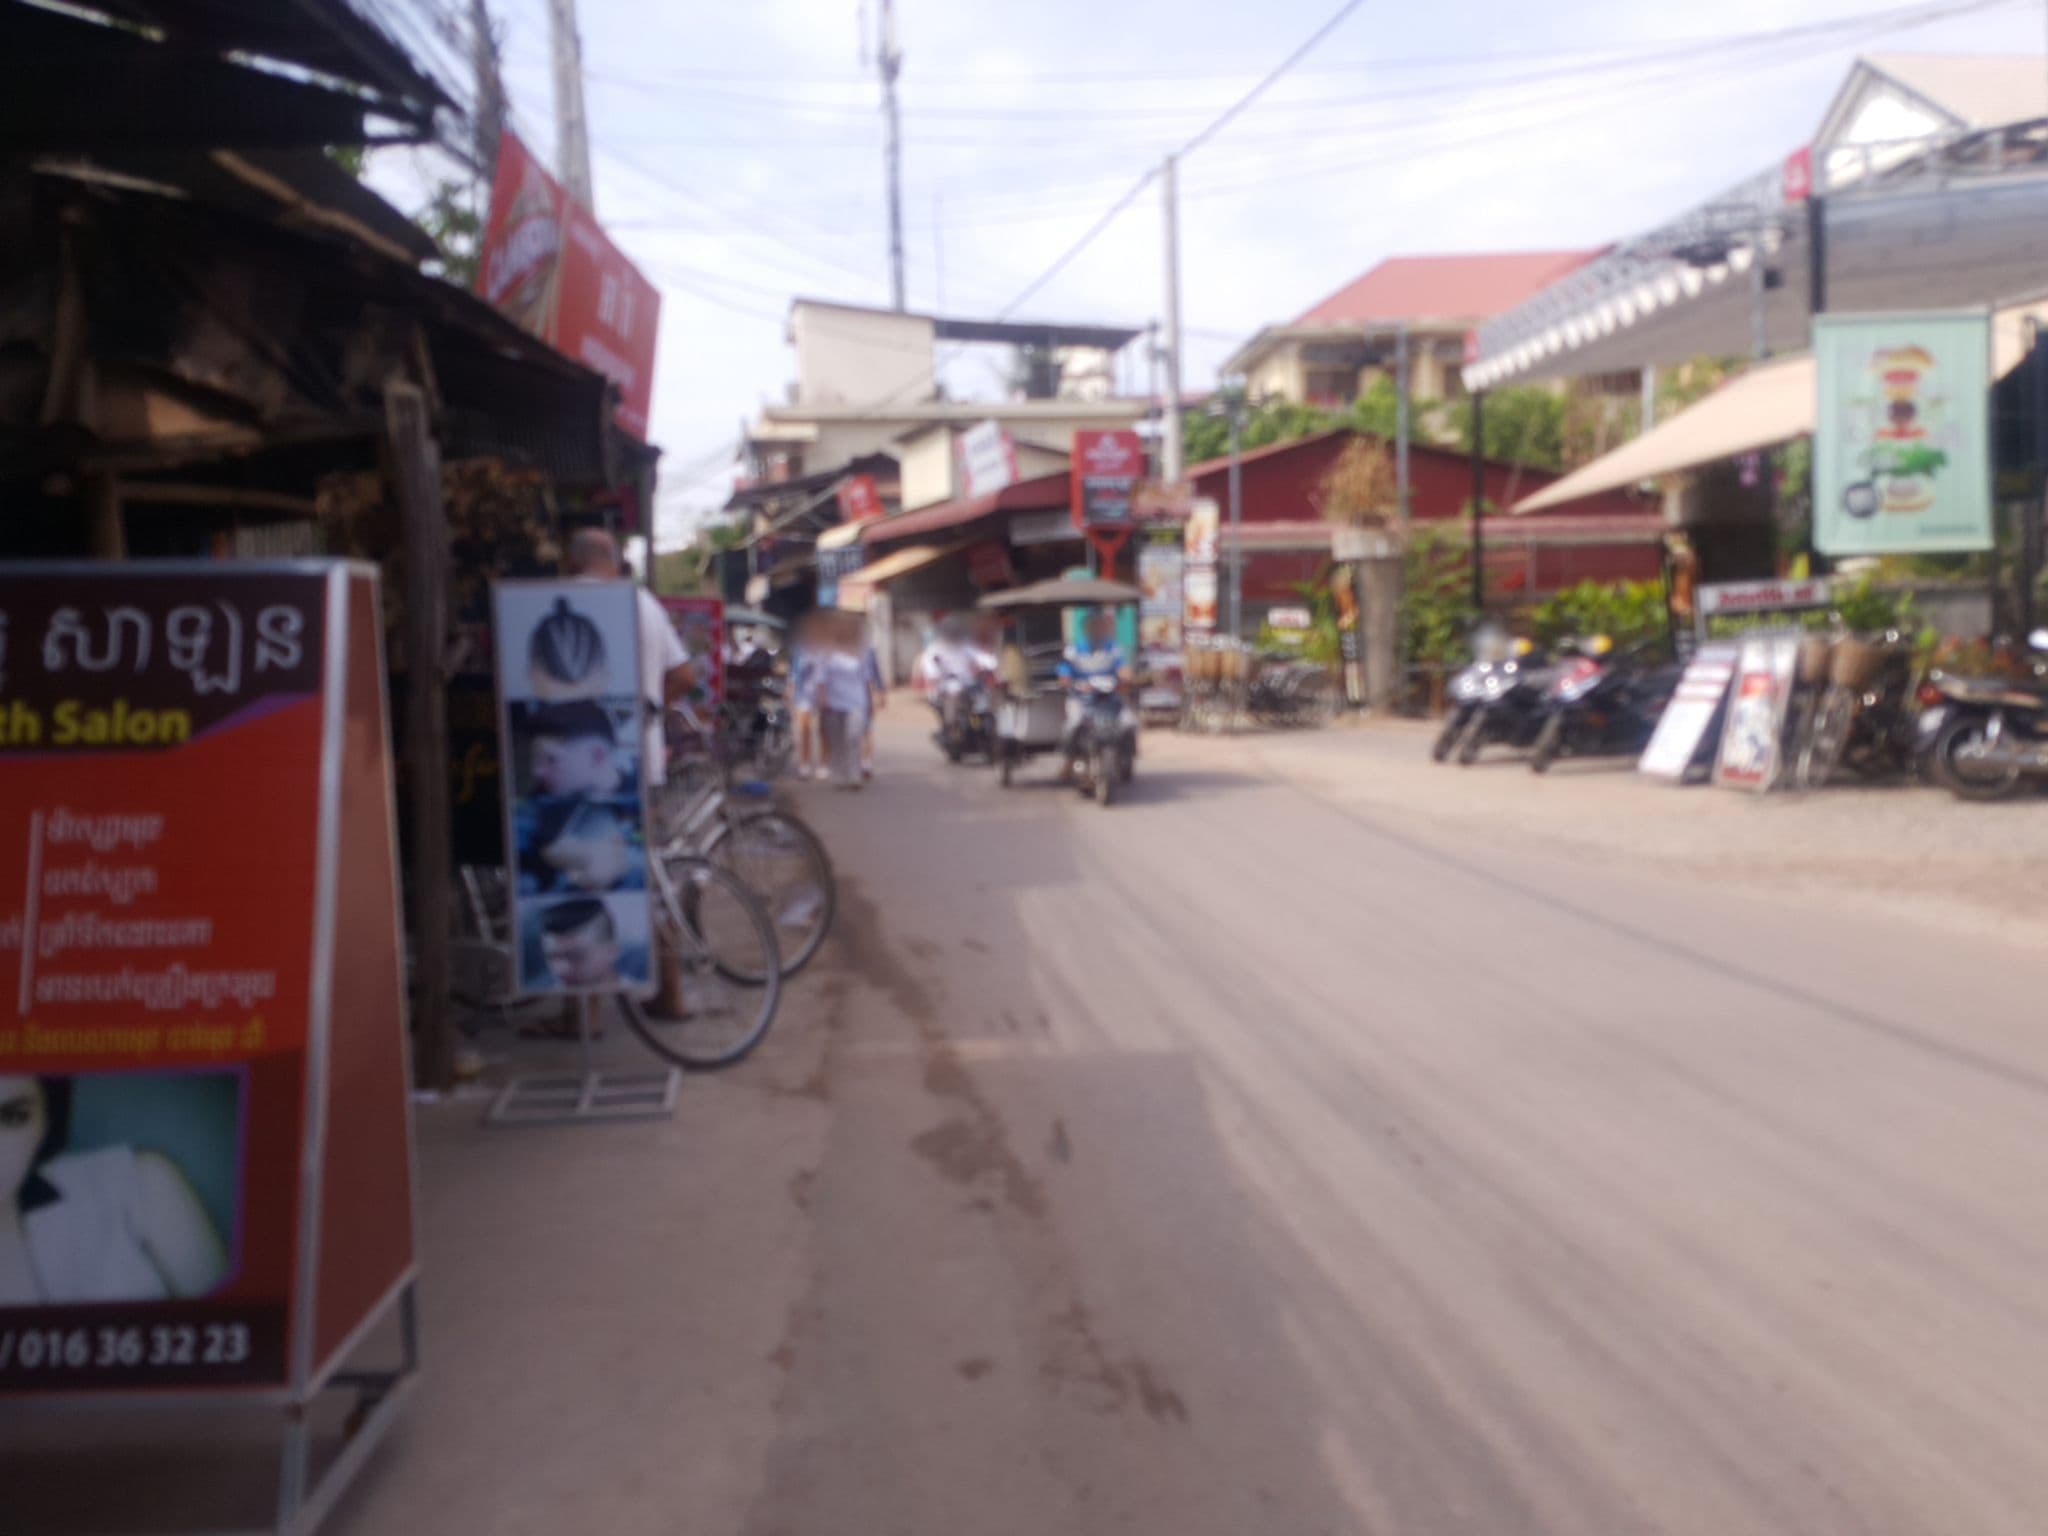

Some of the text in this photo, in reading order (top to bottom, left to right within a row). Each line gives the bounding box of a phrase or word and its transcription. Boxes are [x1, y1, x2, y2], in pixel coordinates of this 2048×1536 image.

[53, 700, 191, 744] Salon
[97, 1327, 143, 1366] 36
[148, 1325, 197, 1364] 32
[202, 1322, 250, 1364] 23
